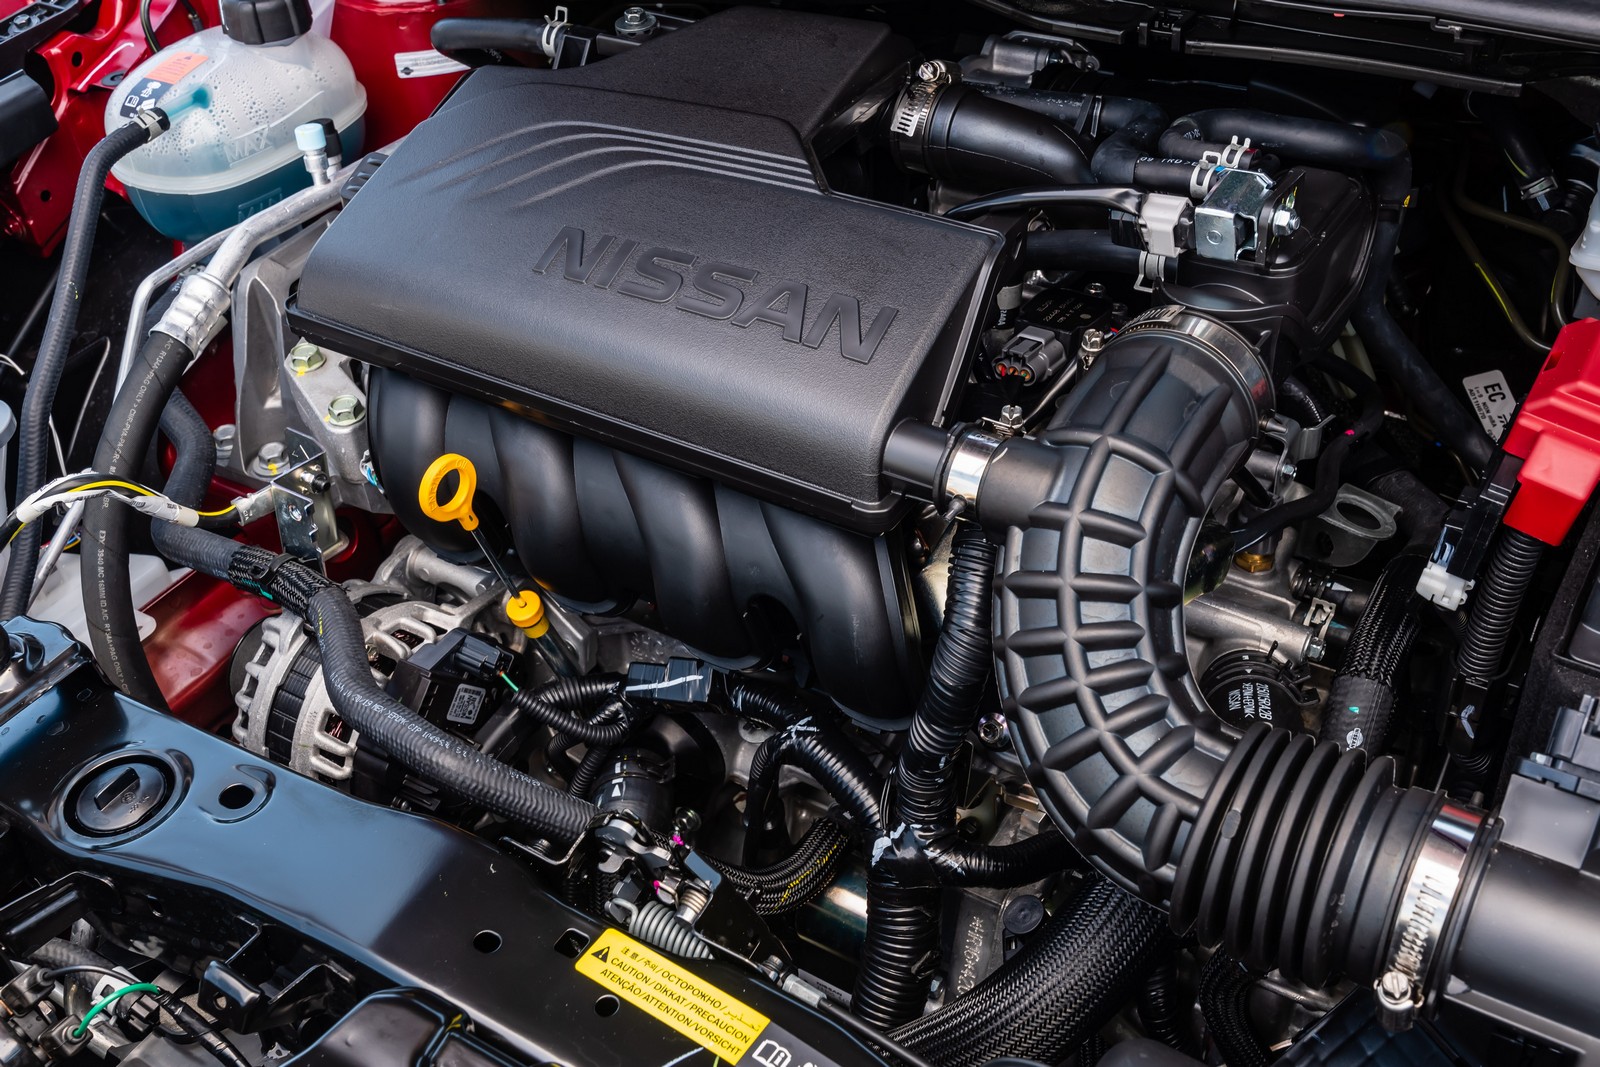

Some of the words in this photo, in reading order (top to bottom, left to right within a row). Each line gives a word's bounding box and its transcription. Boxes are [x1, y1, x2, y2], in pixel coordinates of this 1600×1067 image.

[224, 128, 273, 162] MAX
[532, 225, 899, 364] NISSAN
[1484, 383, 1506, 402] EC
